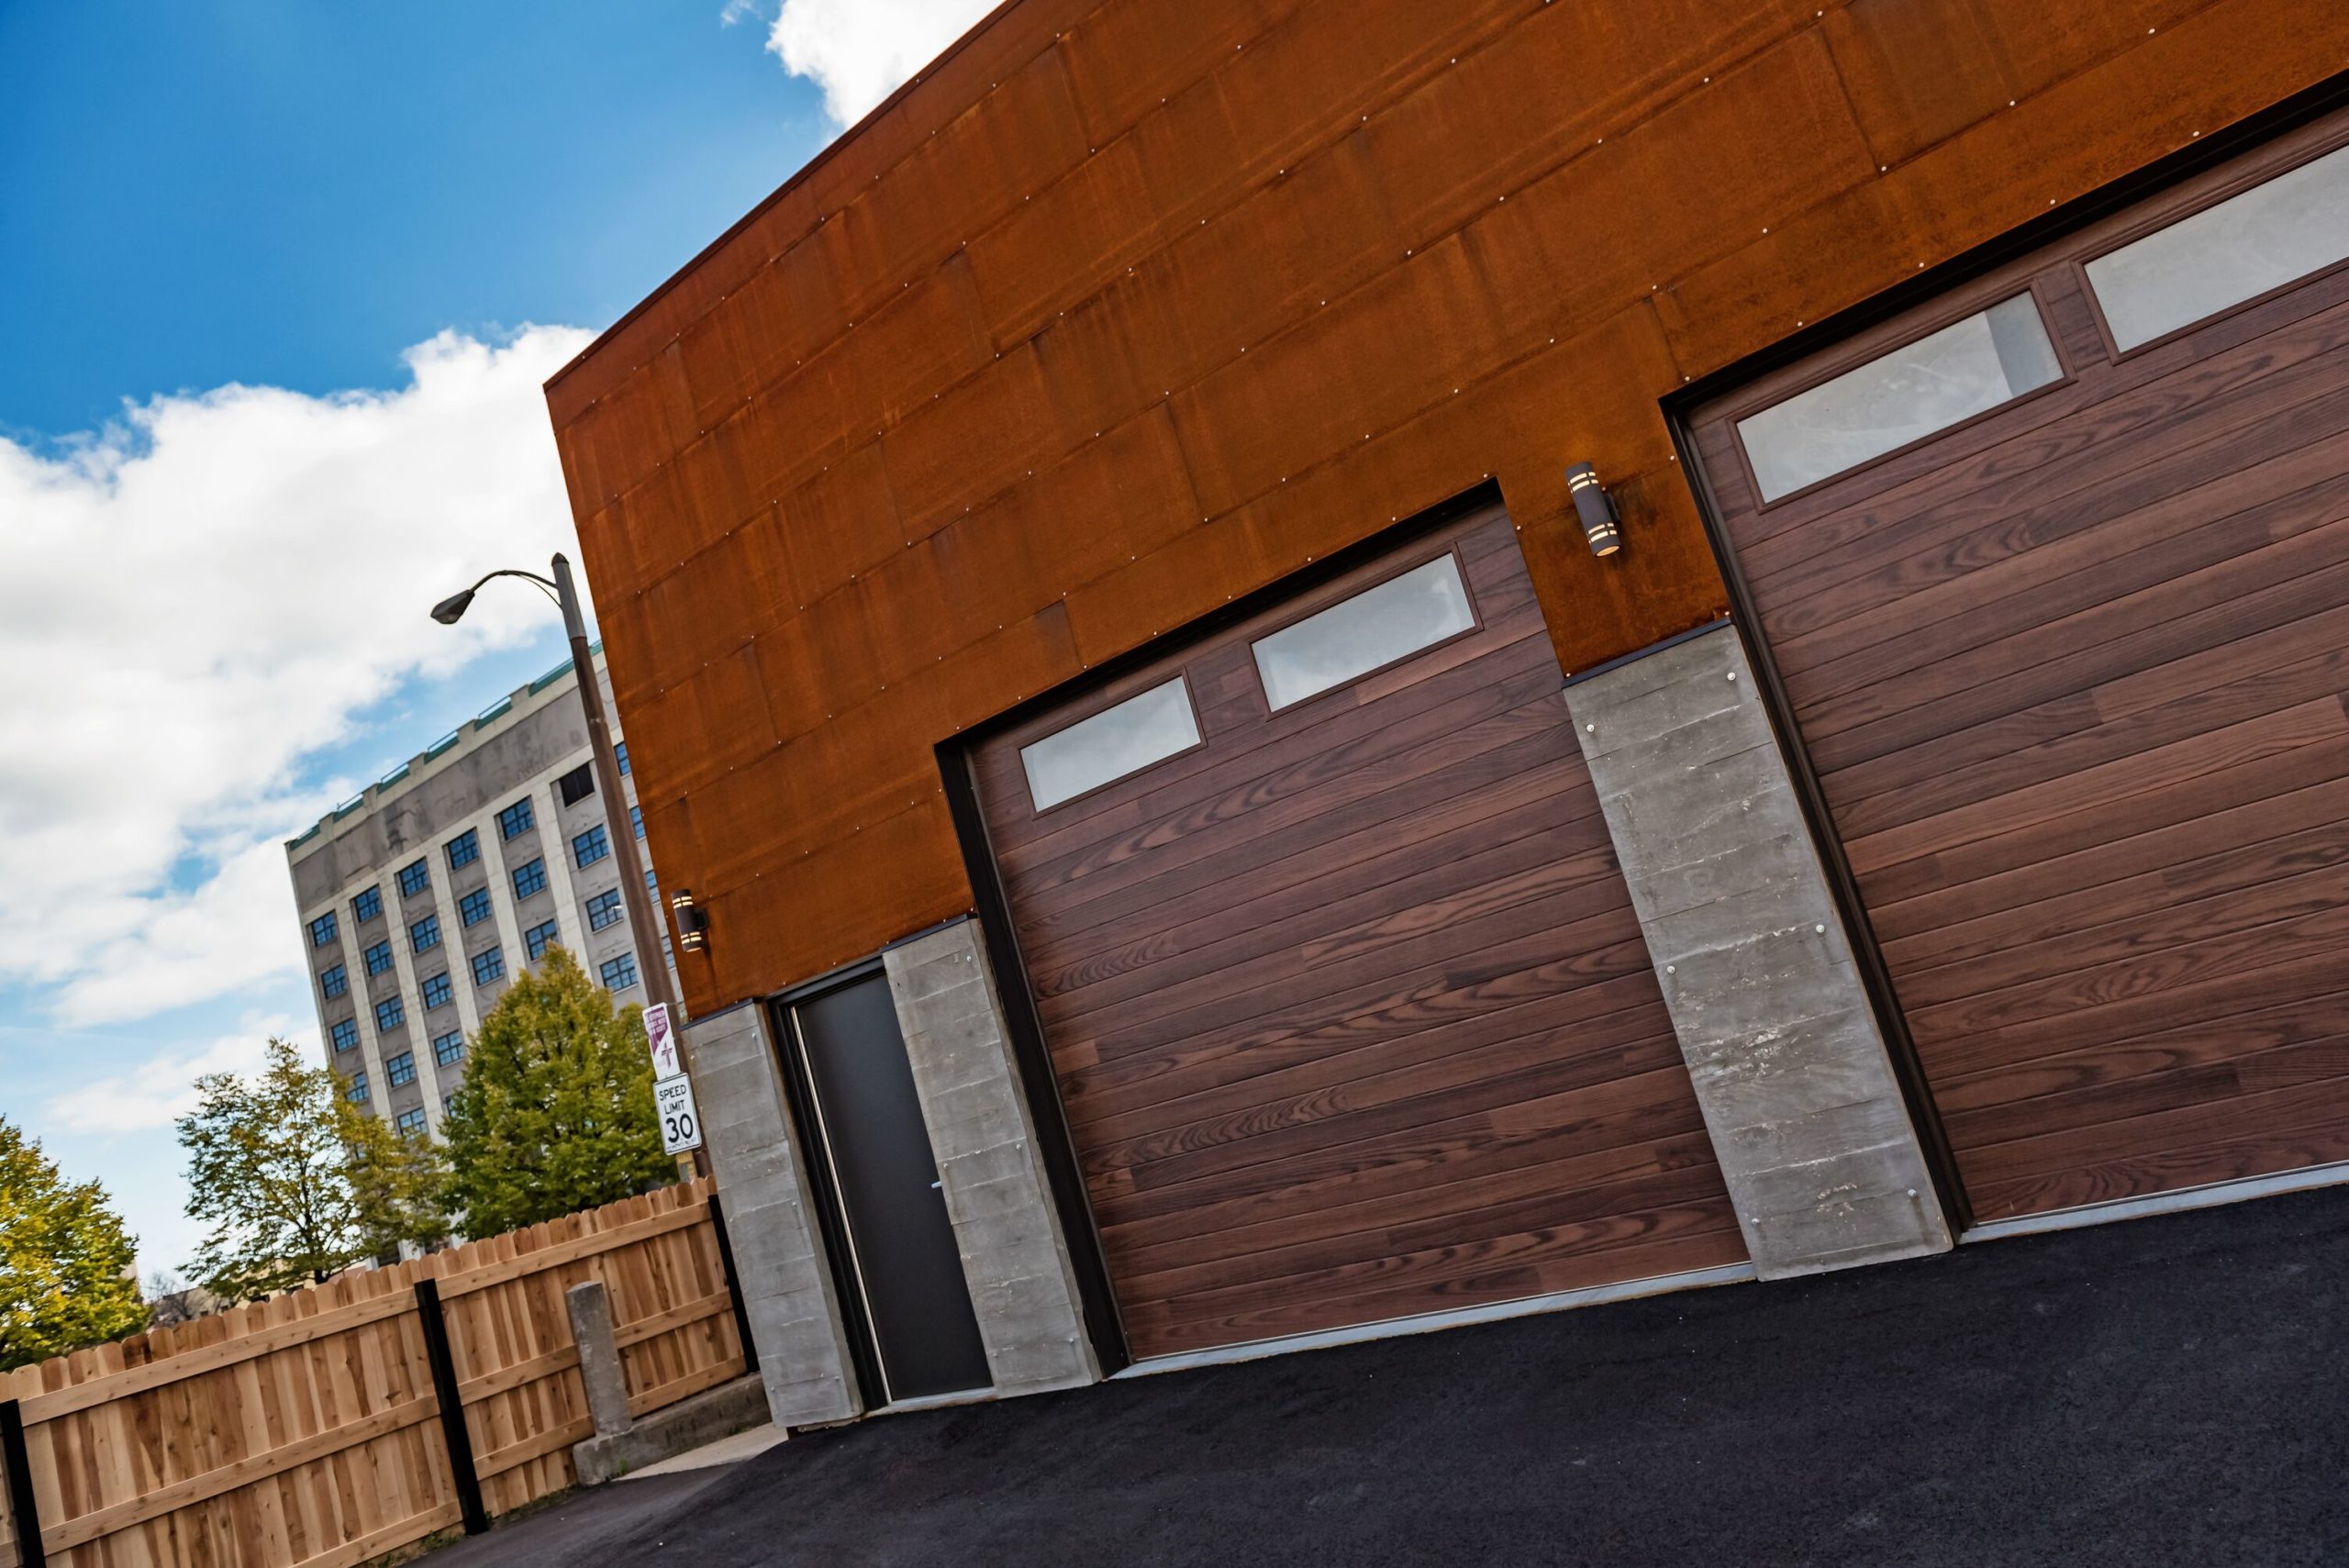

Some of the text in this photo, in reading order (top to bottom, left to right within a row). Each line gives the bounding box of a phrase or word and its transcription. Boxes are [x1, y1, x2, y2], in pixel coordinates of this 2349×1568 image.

[659, 1084, 686, 1101] SPEED
[663, 1099, 685, 1115] LIMIT
[665, 1113, 694, 1143] 30
